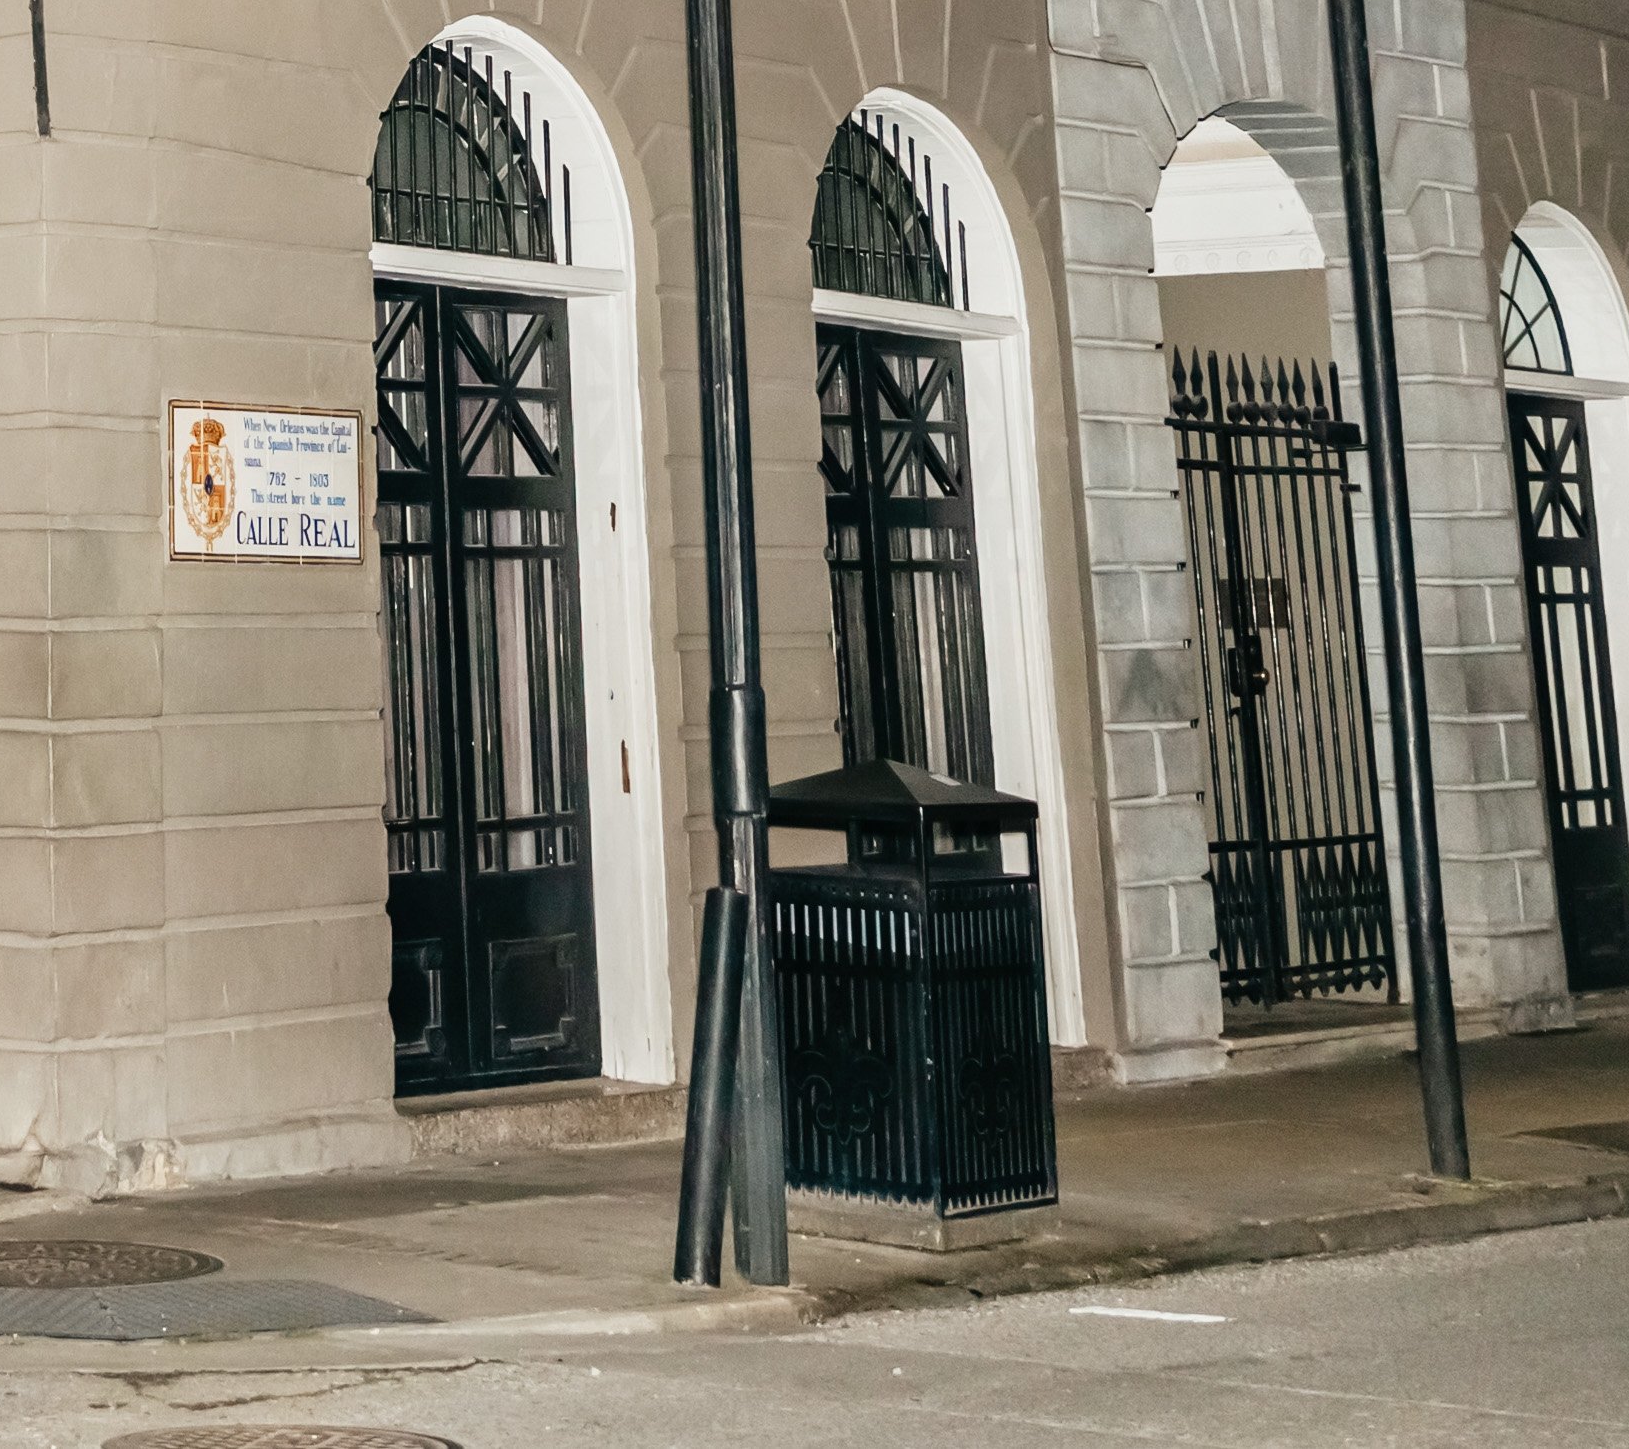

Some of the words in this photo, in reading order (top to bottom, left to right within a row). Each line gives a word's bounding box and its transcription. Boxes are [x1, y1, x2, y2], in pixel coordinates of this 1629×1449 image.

[243, 417, 261, 431] When
[280, 419, 304, 433] Orleans
[306, 425, 318, 434] was
[320, 421, 329, 435] the
[332, 421, 351, 436] Capital
[244, 435, 251, 448] of
[254, 435, 264, 449] the
[268, 436, 293, 454] Spanish
[296, 437, 324, 452] Province
[328, 439, 335, 452] of
[310, 473, 329, 488] 1803
[251, 489, 264, 503] This
[267, 492, 287, 503] street
[311, 491, 321, 505] the
[327, 496, 346, 506] name
[237, 511, 288, 546] CALLE
[299, 513, 355, 548] REAL
